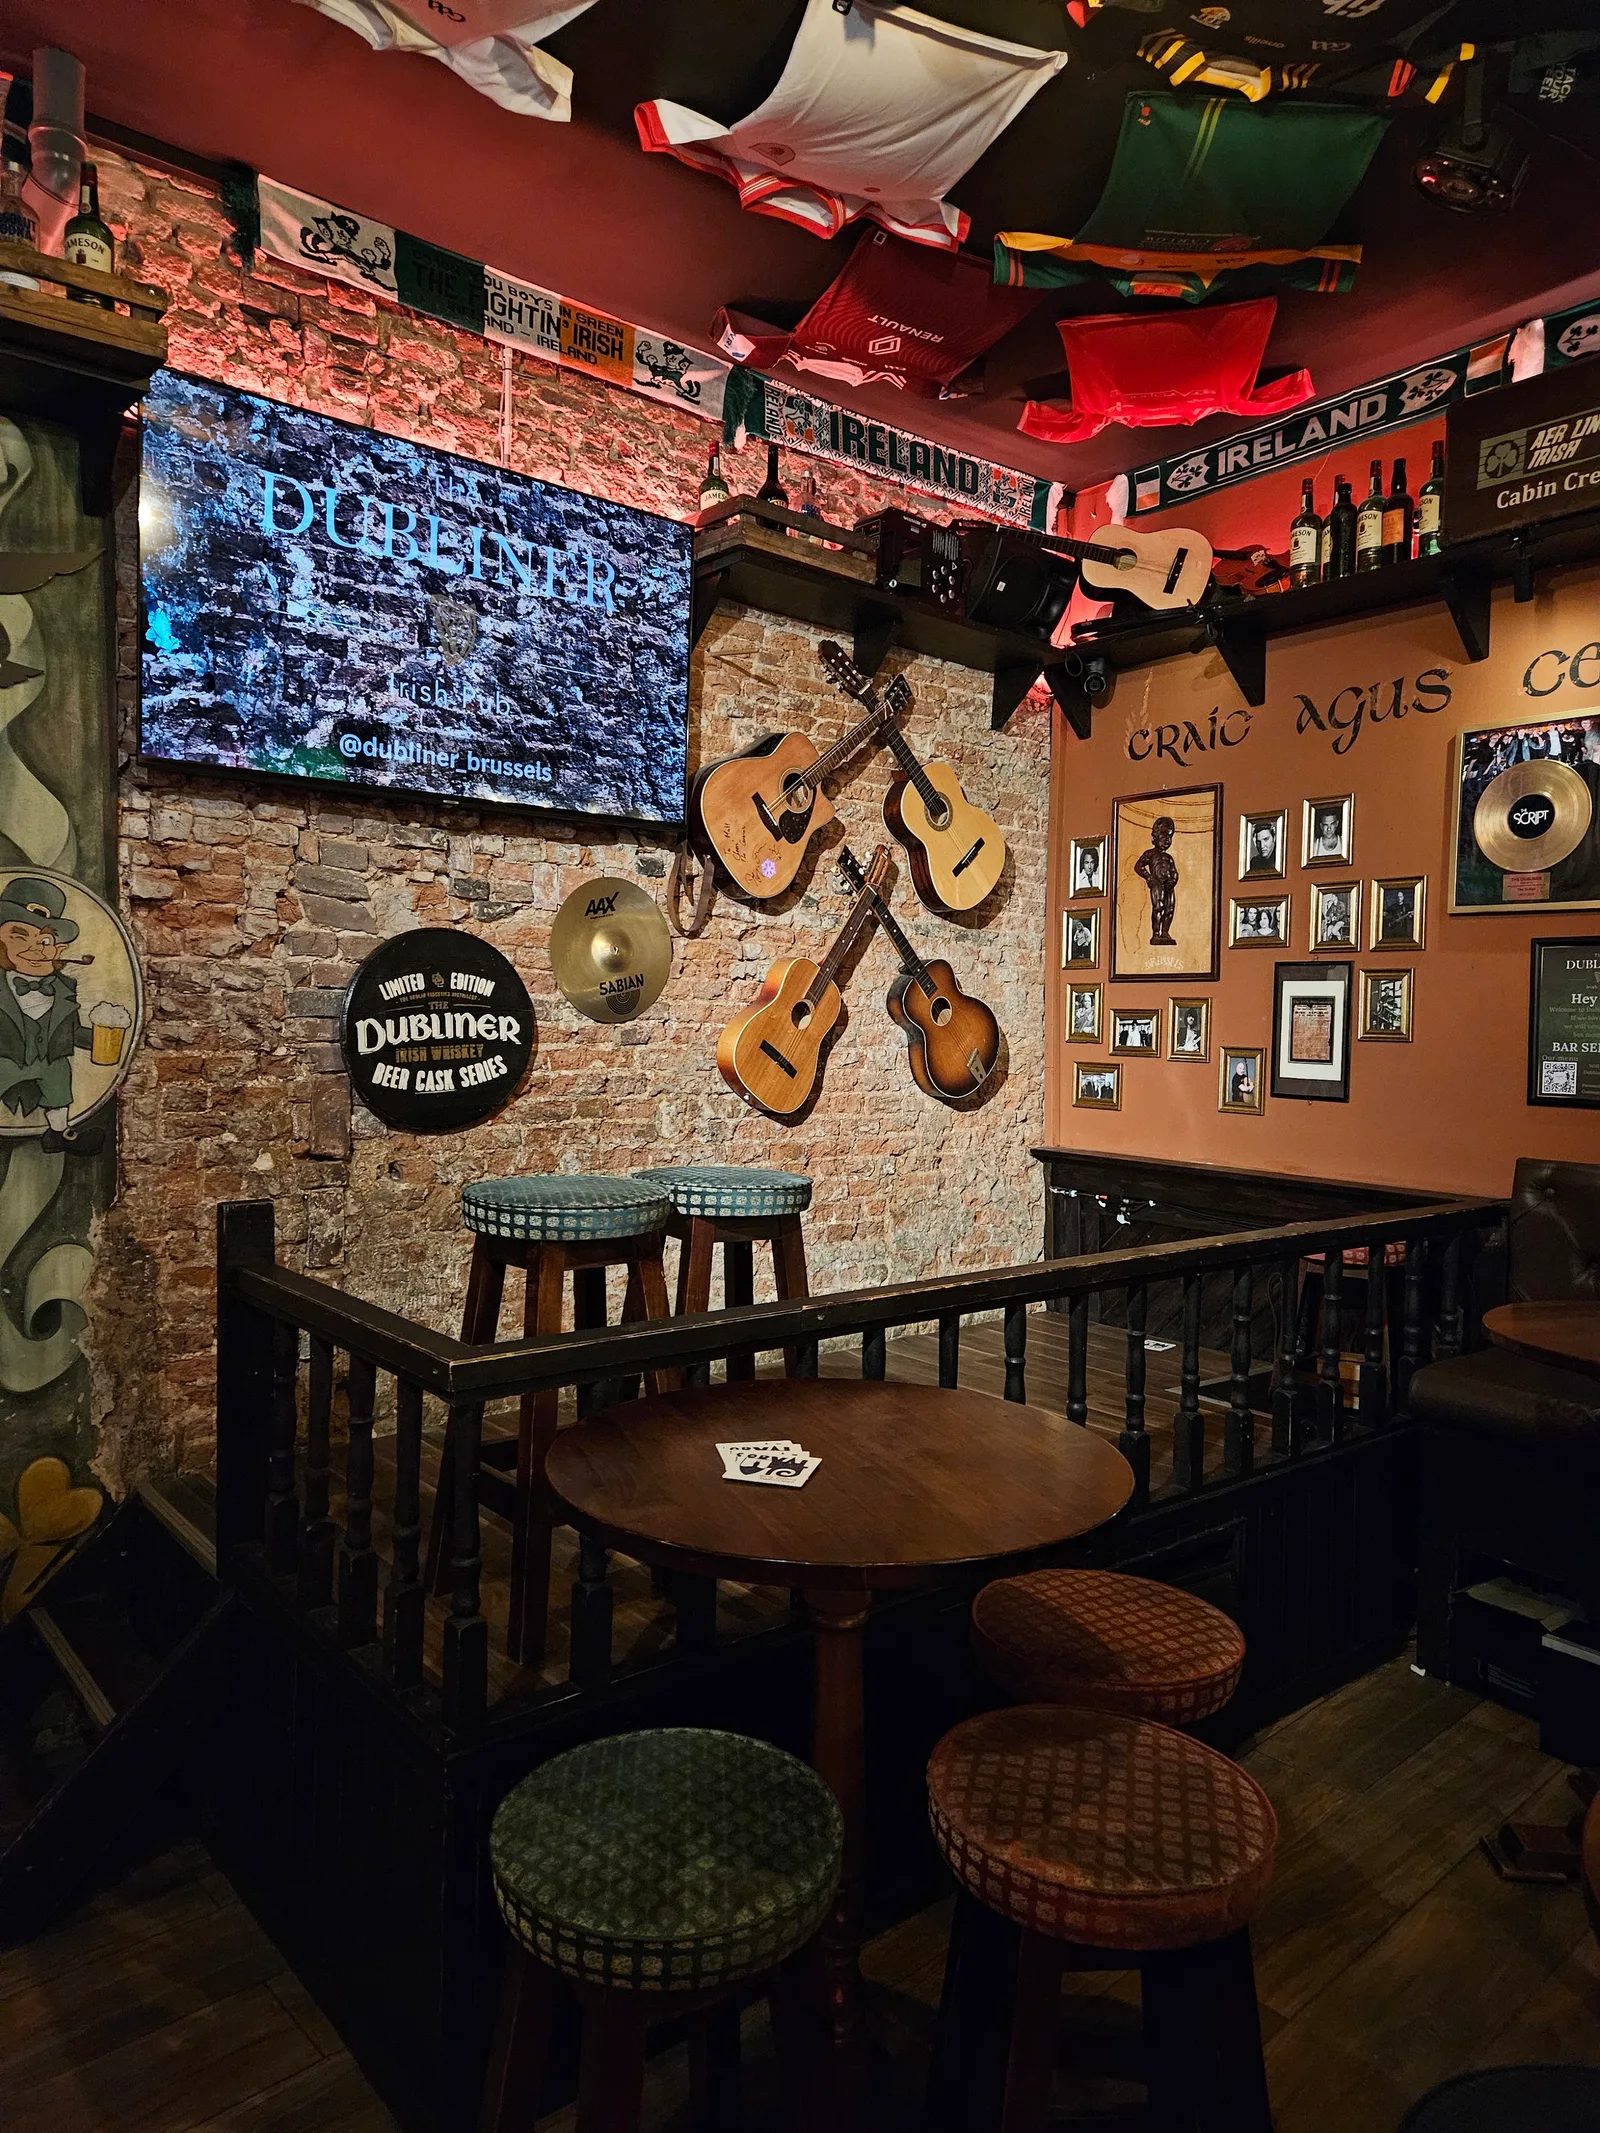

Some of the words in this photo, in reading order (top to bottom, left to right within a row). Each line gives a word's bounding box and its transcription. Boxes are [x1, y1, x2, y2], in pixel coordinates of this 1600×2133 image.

[1547, 61, 1567, 99] YOUR
[508, 286, 553, 311] BOYS
[558, 304, 573, 320] IN
[575, 311, 624, 338] GREEN
[866, 313, 945, 344] RENAULT
[536, 334, 598, 366] IRELAND
[573, 323, 624, 361] IRISH
[764, 384, 783, 435] IRELAND
[1217, 393, 1389, 476] IRELAND
[1529, 423, 1569, 451] AER
[1569, 413, 1600, 440] LIN
[829, 409, 980, 497] IRELAND
[1527, 438, 1582, 470] IRISH
[1017, 476, 1036, 520] IRELAND
[1496, 480, 1558, 509] Cabin
[256, 470, 618, 614] DUBLINER
[389, 673, 447, 702] Irish
[463, 691, 512, 718] Pub
[1294, 668, 1454, 755] AGUS
[337, 733, 553, 783] @dubliner_brussels
[1513, 810, 1550, 826] SCRIPT
[583, 891, 621, 917] AAX
[378, 972, 426, 1001] LIMITED
[450, 972, 496, 998] EDITION
[599, 973, 645, 996] SABIAN
[1571, 993, 1598, 1008] Hey
[428, 1001, 450, 1010] THE
[355, 1012, 522, 1055] DUBLINER
[1552, 1042, 1578, 1053] BAR
[395, 1047, 428, 1064] IRISH
[430, 1043, 485, 1062] WHISKEY
[371, 1062, 410, 1091] BEER
[414, 1068, 456, 1093] CASK
[458, 1054, 508, 1088] SERIES
